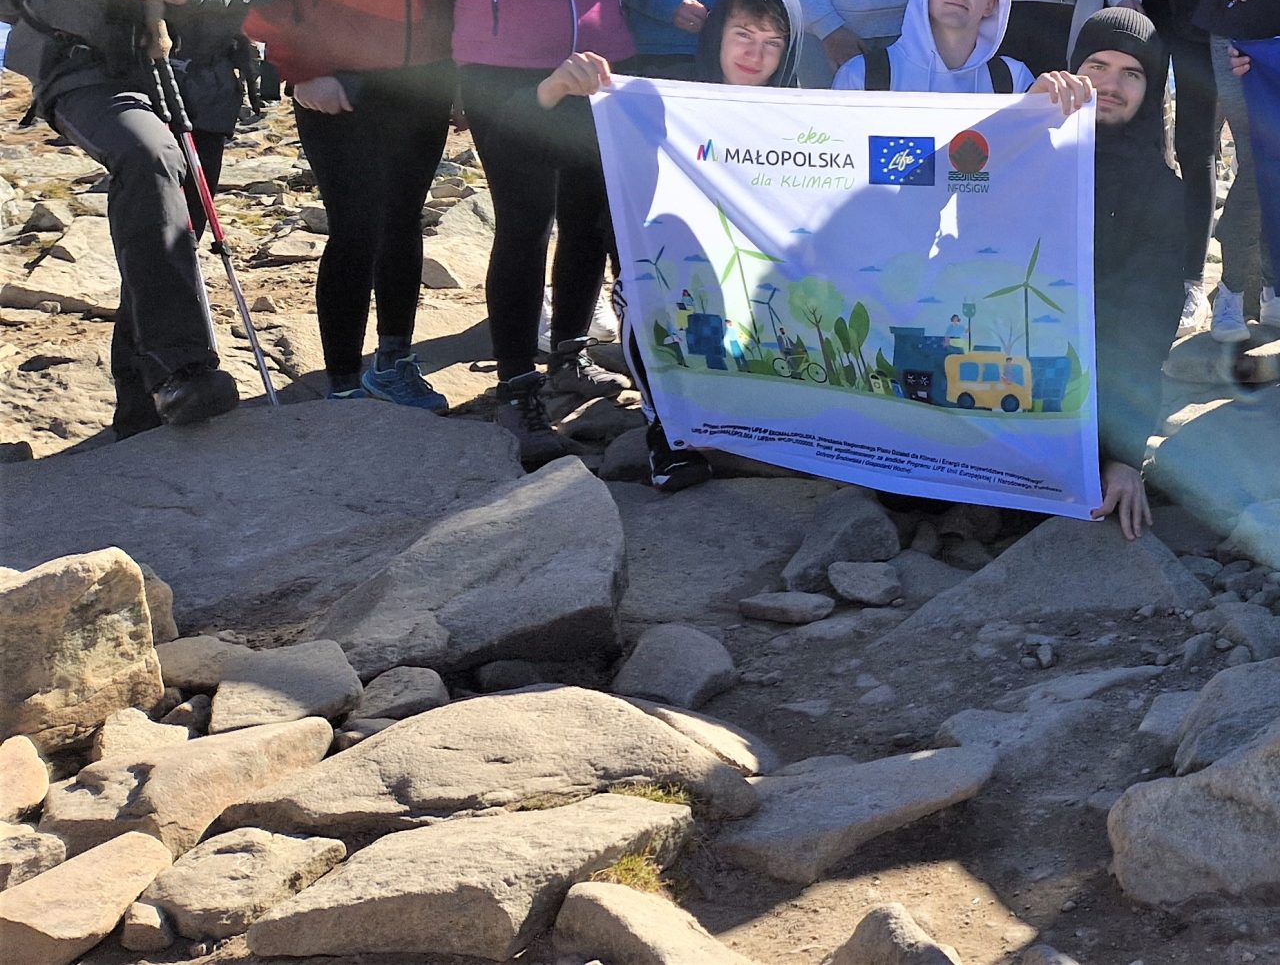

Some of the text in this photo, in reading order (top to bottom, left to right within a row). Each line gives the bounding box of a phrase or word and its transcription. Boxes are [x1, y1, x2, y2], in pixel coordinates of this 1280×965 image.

[797, 126, 830, 145] eko
[724, 147, 855, 169] MAŁOPOLSKA
[888, 148, 915, 171] Life
[751, 174, 855, 191] dla KLIMATU
